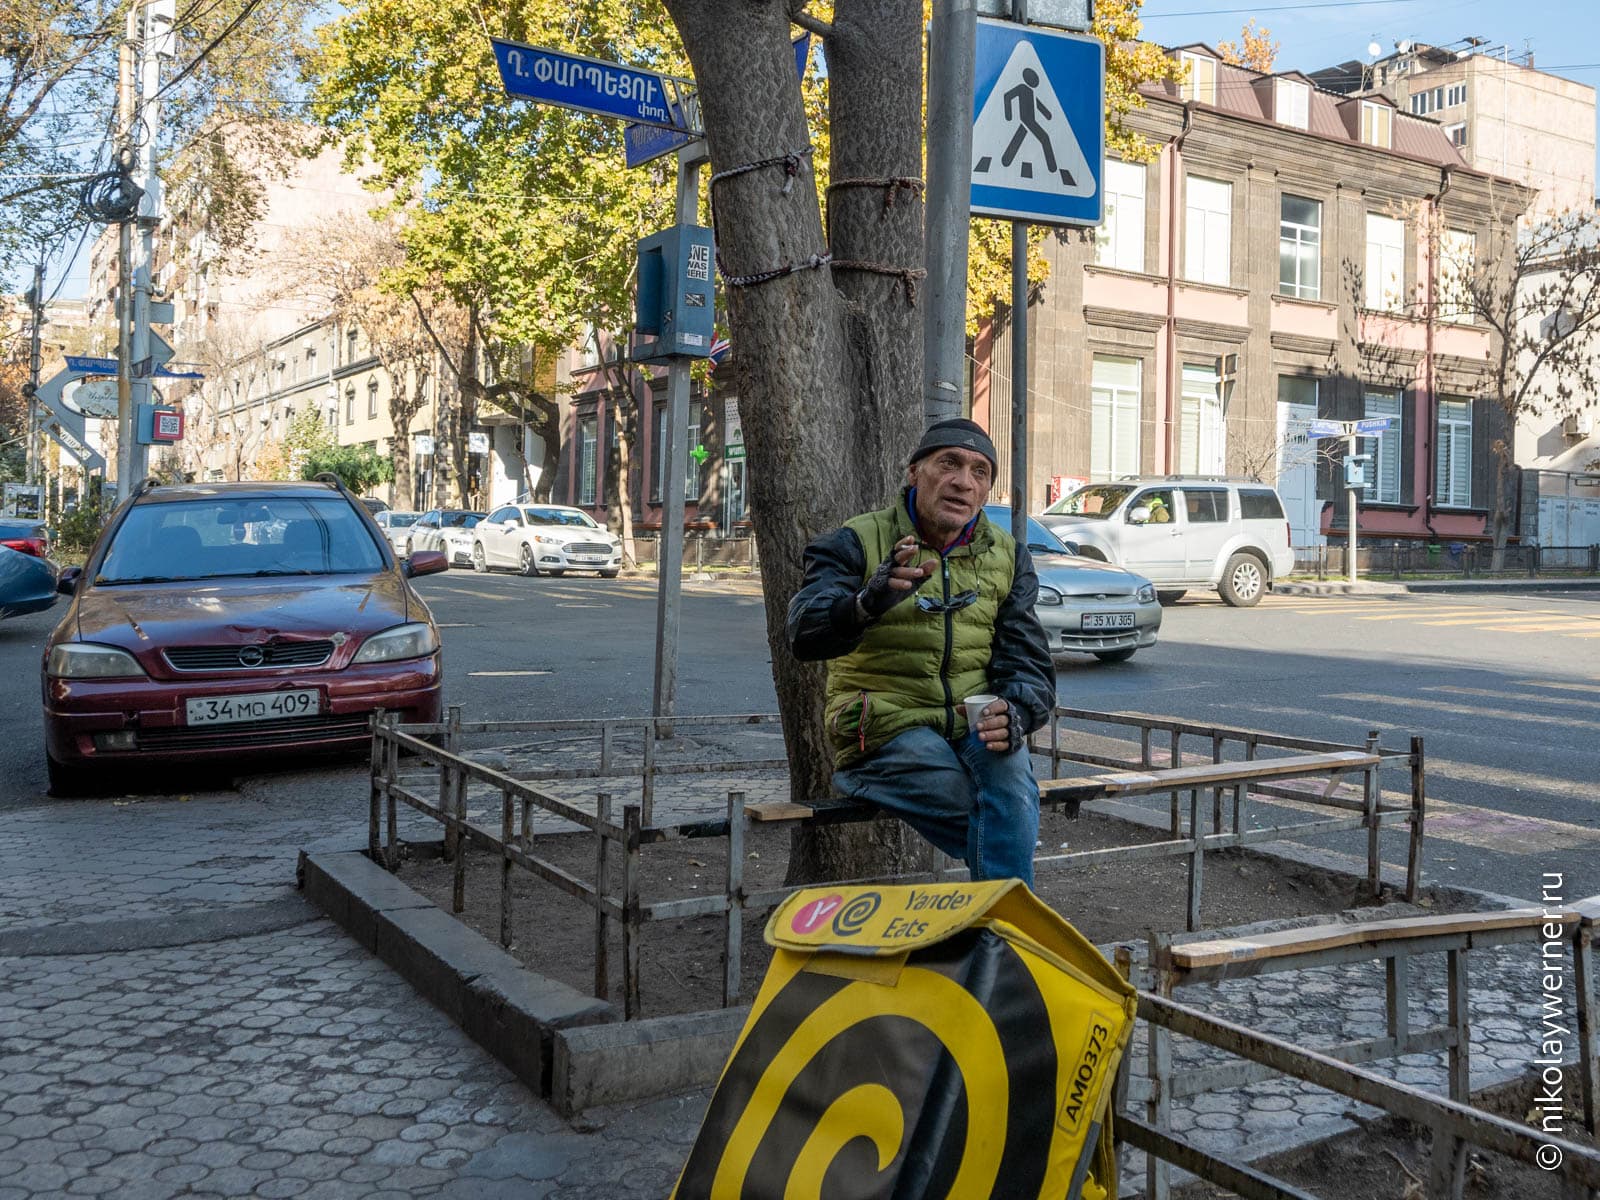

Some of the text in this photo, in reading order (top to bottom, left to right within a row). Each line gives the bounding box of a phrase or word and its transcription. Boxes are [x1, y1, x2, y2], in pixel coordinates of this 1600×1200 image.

[534, 57, 658, 103] ՓԱՐՊԵՑՈՒ
[637, 102, 669, 121] փող.
[1093, 615, 1104, 626] 35
[1105, 615, 1117, 626] XV
[1118, 615, 1133, 626] 305
[206, 700, 233, 720] 34
[270, 693, 311, 715] 409
[904, 889, 974, 911] Yandex
[881, 917, 929, 939] Eats
